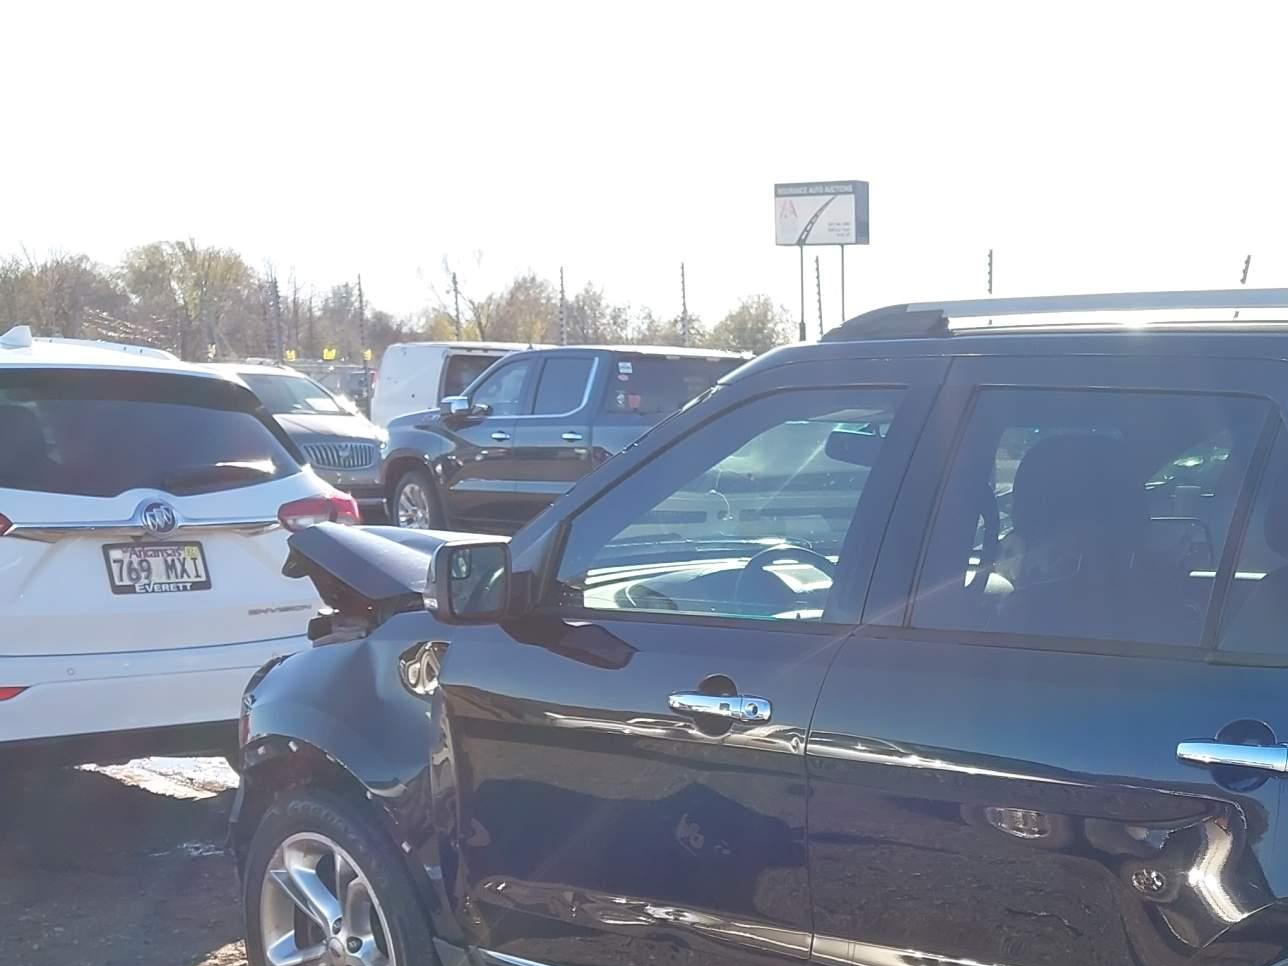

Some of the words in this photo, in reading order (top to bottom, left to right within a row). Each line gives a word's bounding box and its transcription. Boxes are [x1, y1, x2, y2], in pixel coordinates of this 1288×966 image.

[129, 548, 183, 559] Arkansas
[112, 559, 153, 584] 769
[164, 557, 202, 580] MXI
[135, 582, 192, 593] EVERETT
